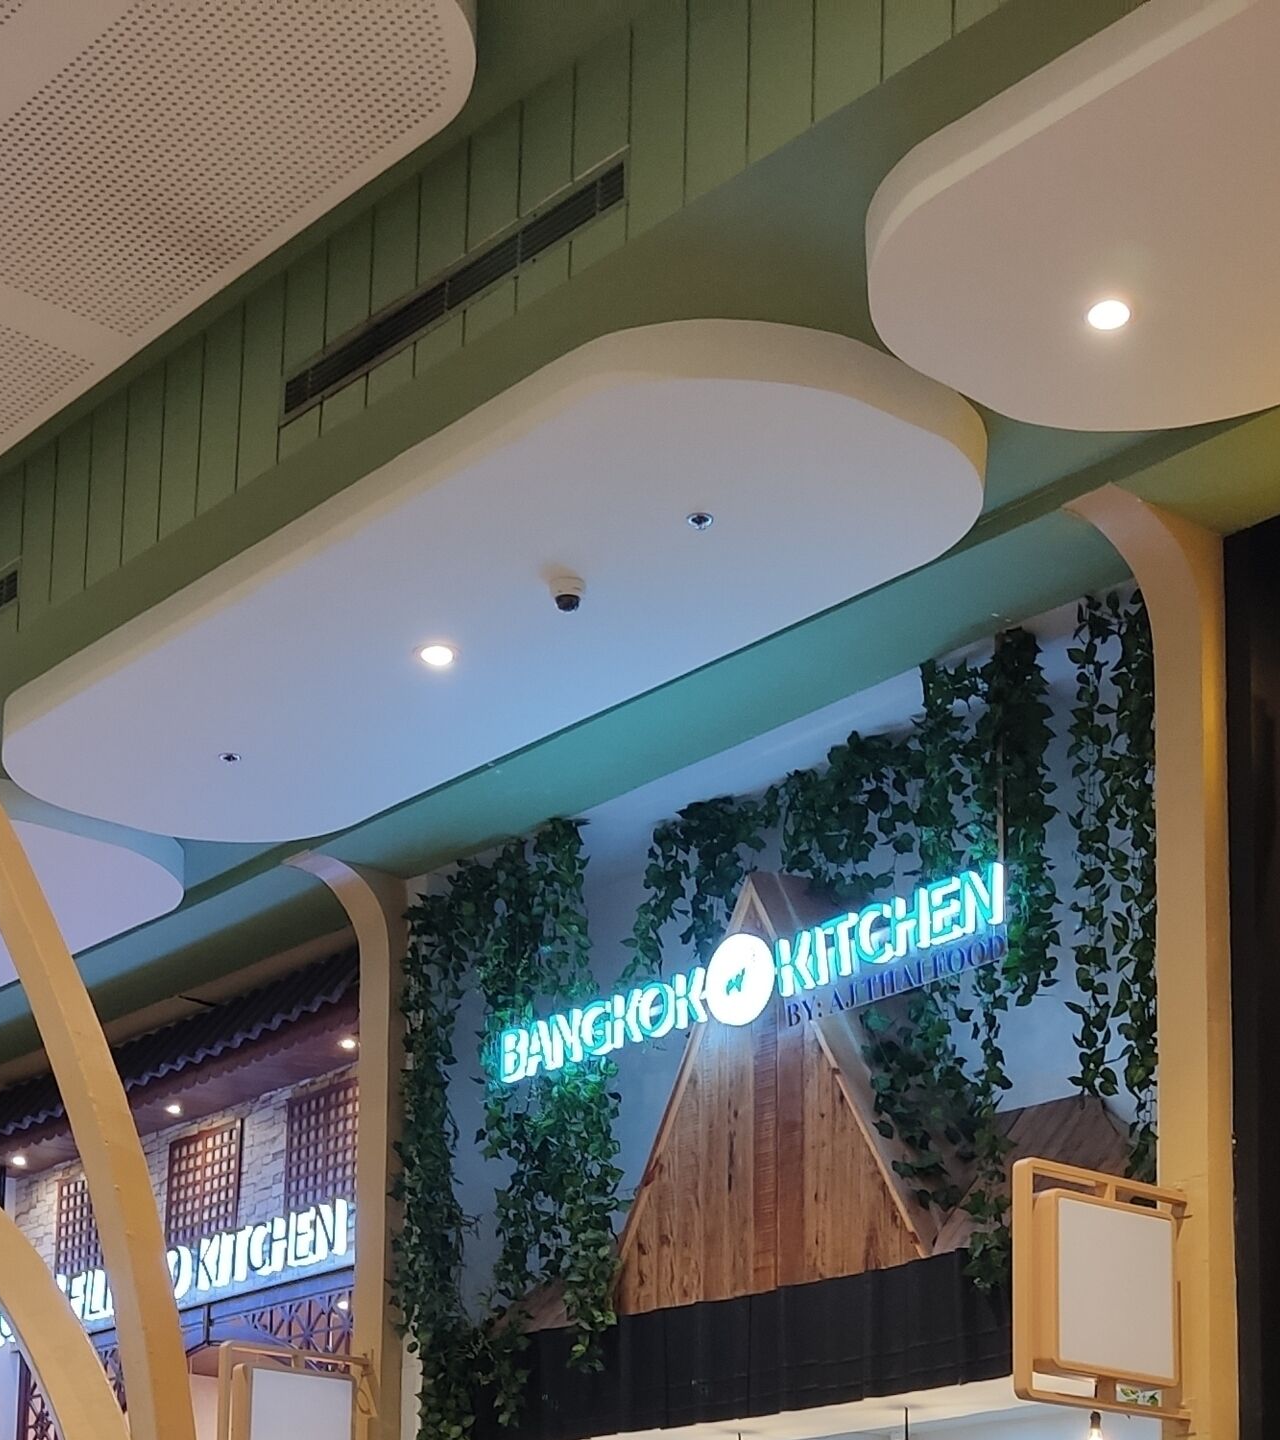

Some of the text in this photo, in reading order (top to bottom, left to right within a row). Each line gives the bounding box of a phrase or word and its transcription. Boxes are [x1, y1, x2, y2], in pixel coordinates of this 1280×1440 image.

[500, 862, 1005, 1084] BANGKOK KITCHEN
[862, 959, 929, 1002] THAI
[932, 934, 1007, 980] FOOD
[196, 1197, 349, 1292] KITCHEN
